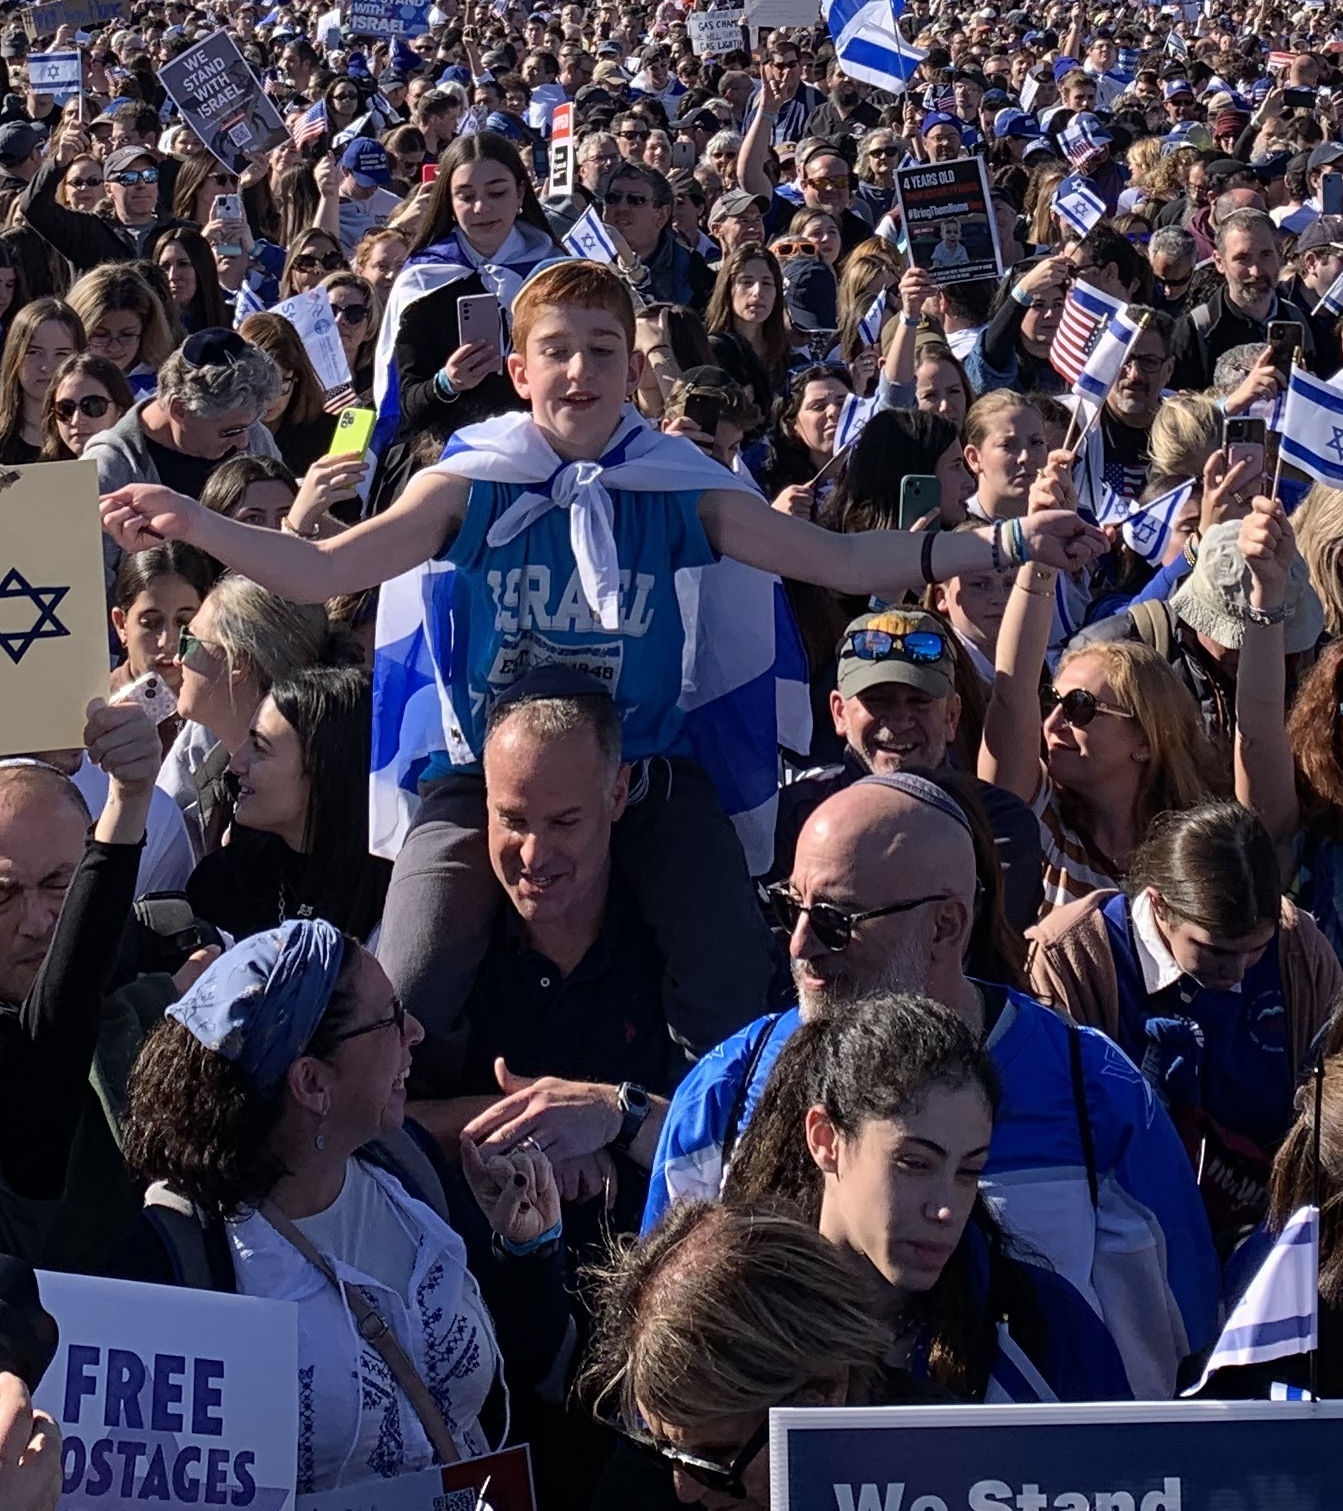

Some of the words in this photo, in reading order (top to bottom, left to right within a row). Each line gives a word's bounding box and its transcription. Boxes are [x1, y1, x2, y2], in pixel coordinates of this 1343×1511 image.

[354, 2, 386, 15] WITH
[351, 15, 407, 33] ISRAEL
[698, 22, 714, 32] GAS
[716, 19, 738, 30] CHAM
[718, 39, 743, 49] LIGHTIN
[183, 49, 208, 72] WE
[183, 57, 226, 92] STAND
[193, 72, 231, 102] WITH
[197, 83, 245, 119] ISRAEL
[903, 177, 911, 190] 4
[911, 172, 939, 189] YEARS
[938, 169, 956, 184] OLD
[61, 1344, 226, 1437] FREE
[59, 1435, 257, 1508] OSTAGES
